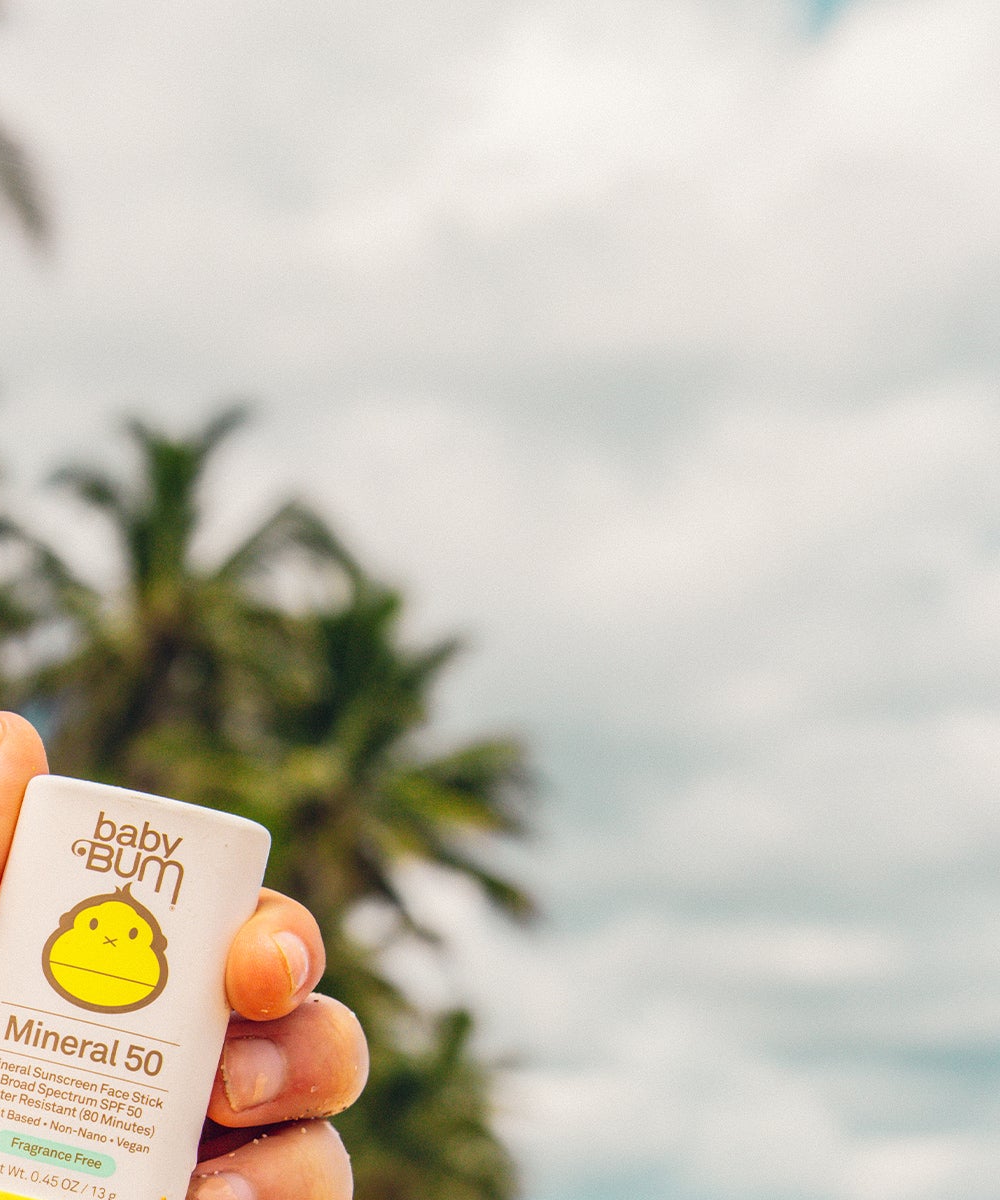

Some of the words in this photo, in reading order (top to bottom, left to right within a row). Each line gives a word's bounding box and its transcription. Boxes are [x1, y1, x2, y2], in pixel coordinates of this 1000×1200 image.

[93, 811, 184, 859] baby
[4, 1014, 119, 1067] Mineral
[124, 1044, 164, 1077] 50
[0, 1073, 35, 1093] Broad
[37, 1082, 98, 1107] Spectrum
[100, 1099, 127, 1113] SPF
[127, 1107, 143, 1119] 50
[32, 1066, 98, 1092] Sunscreen
[100, 1083, 130, 1101] Face
[132, 1091, 164, 1109] Stick
[7, 1109, 41, 1127] Based
[50, 1120, 107, 1143] Non-Nano
[117, 1137, 150, 1154] Vegan
[19, 1093, 78, 1118] Resistant
[79, 1108, 99, 1123] (80
[100, 1114, 156, 1138] Minutes)
[11, 1137, 73, 1161] Fragrance
[74, 1152, 103, 1169] Free
[8, 1167, 28, 1181] Wt.
[30, 1170, 59, 1188] 0.45
[61, 1179, 80, 1193] OZ
[91, 1186, 107, 1199] 13
